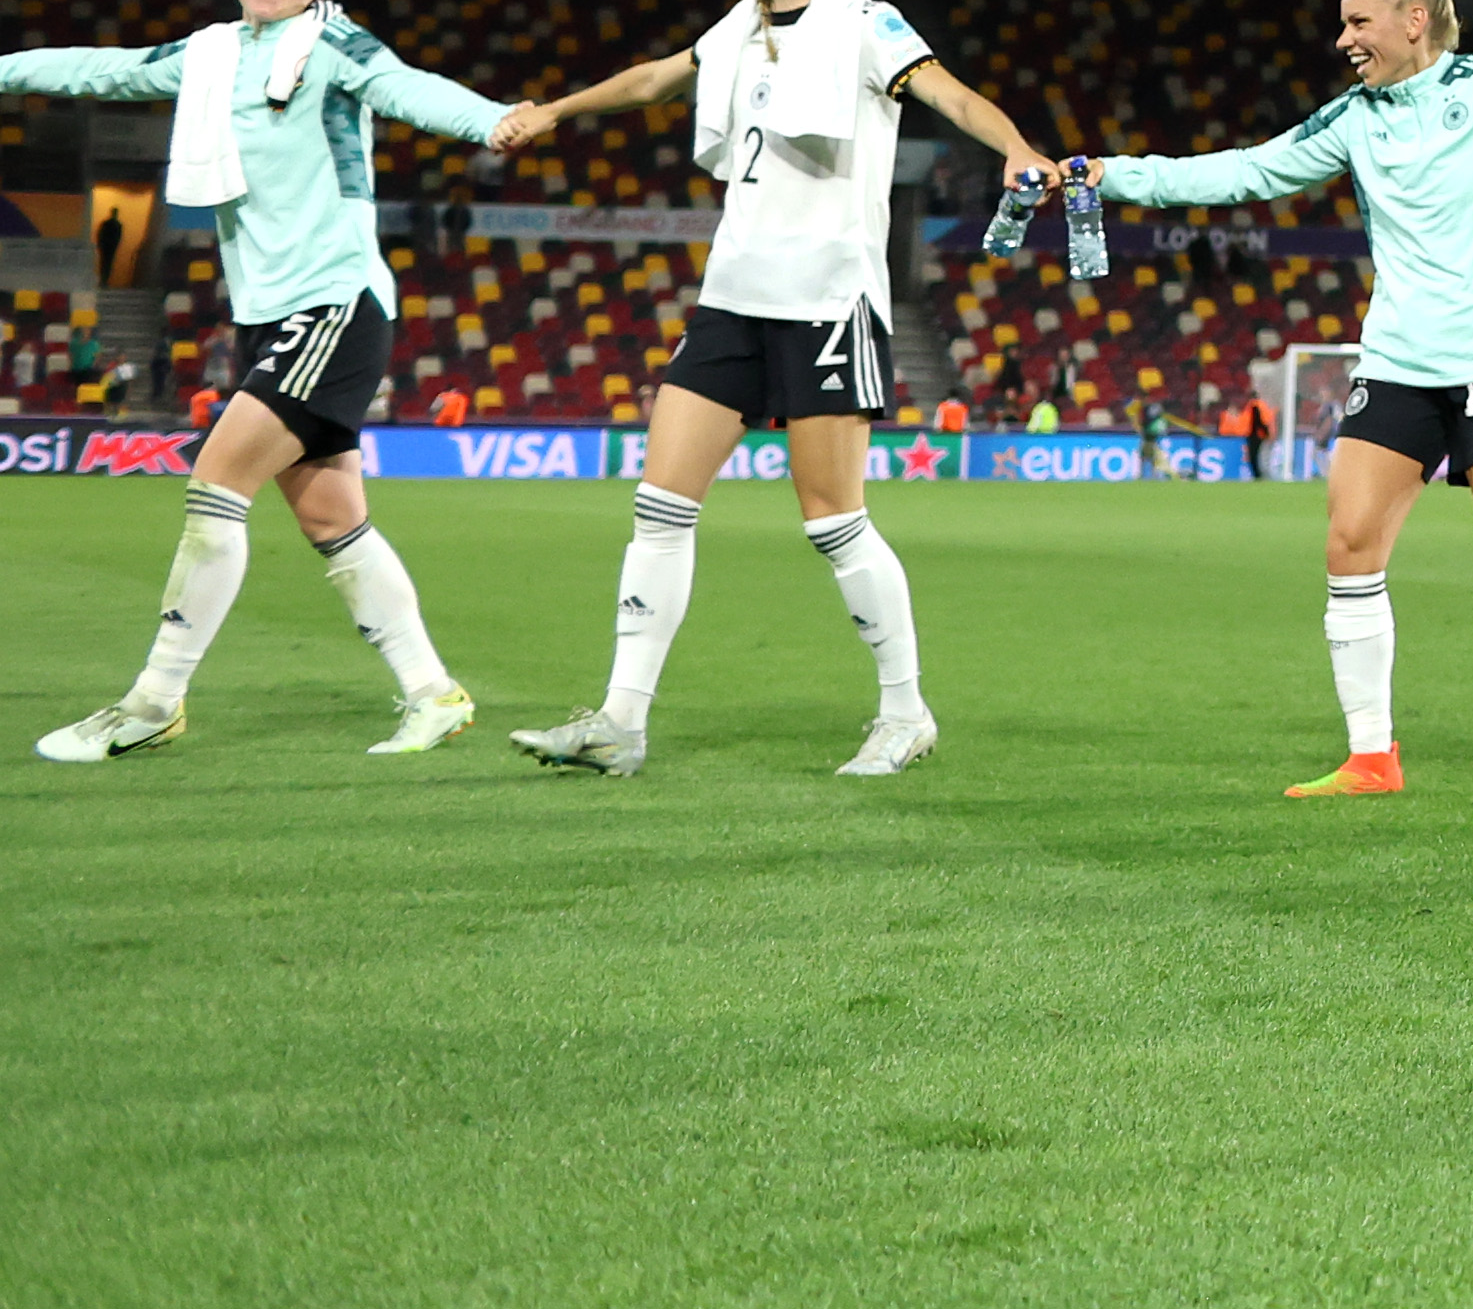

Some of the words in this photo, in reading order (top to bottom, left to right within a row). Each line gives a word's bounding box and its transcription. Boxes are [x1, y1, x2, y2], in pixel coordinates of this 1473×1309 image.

[740, 125, 763, 184] 2
[270, 312, 316, 353] 5
[450, 433, 581, 477] VISA
